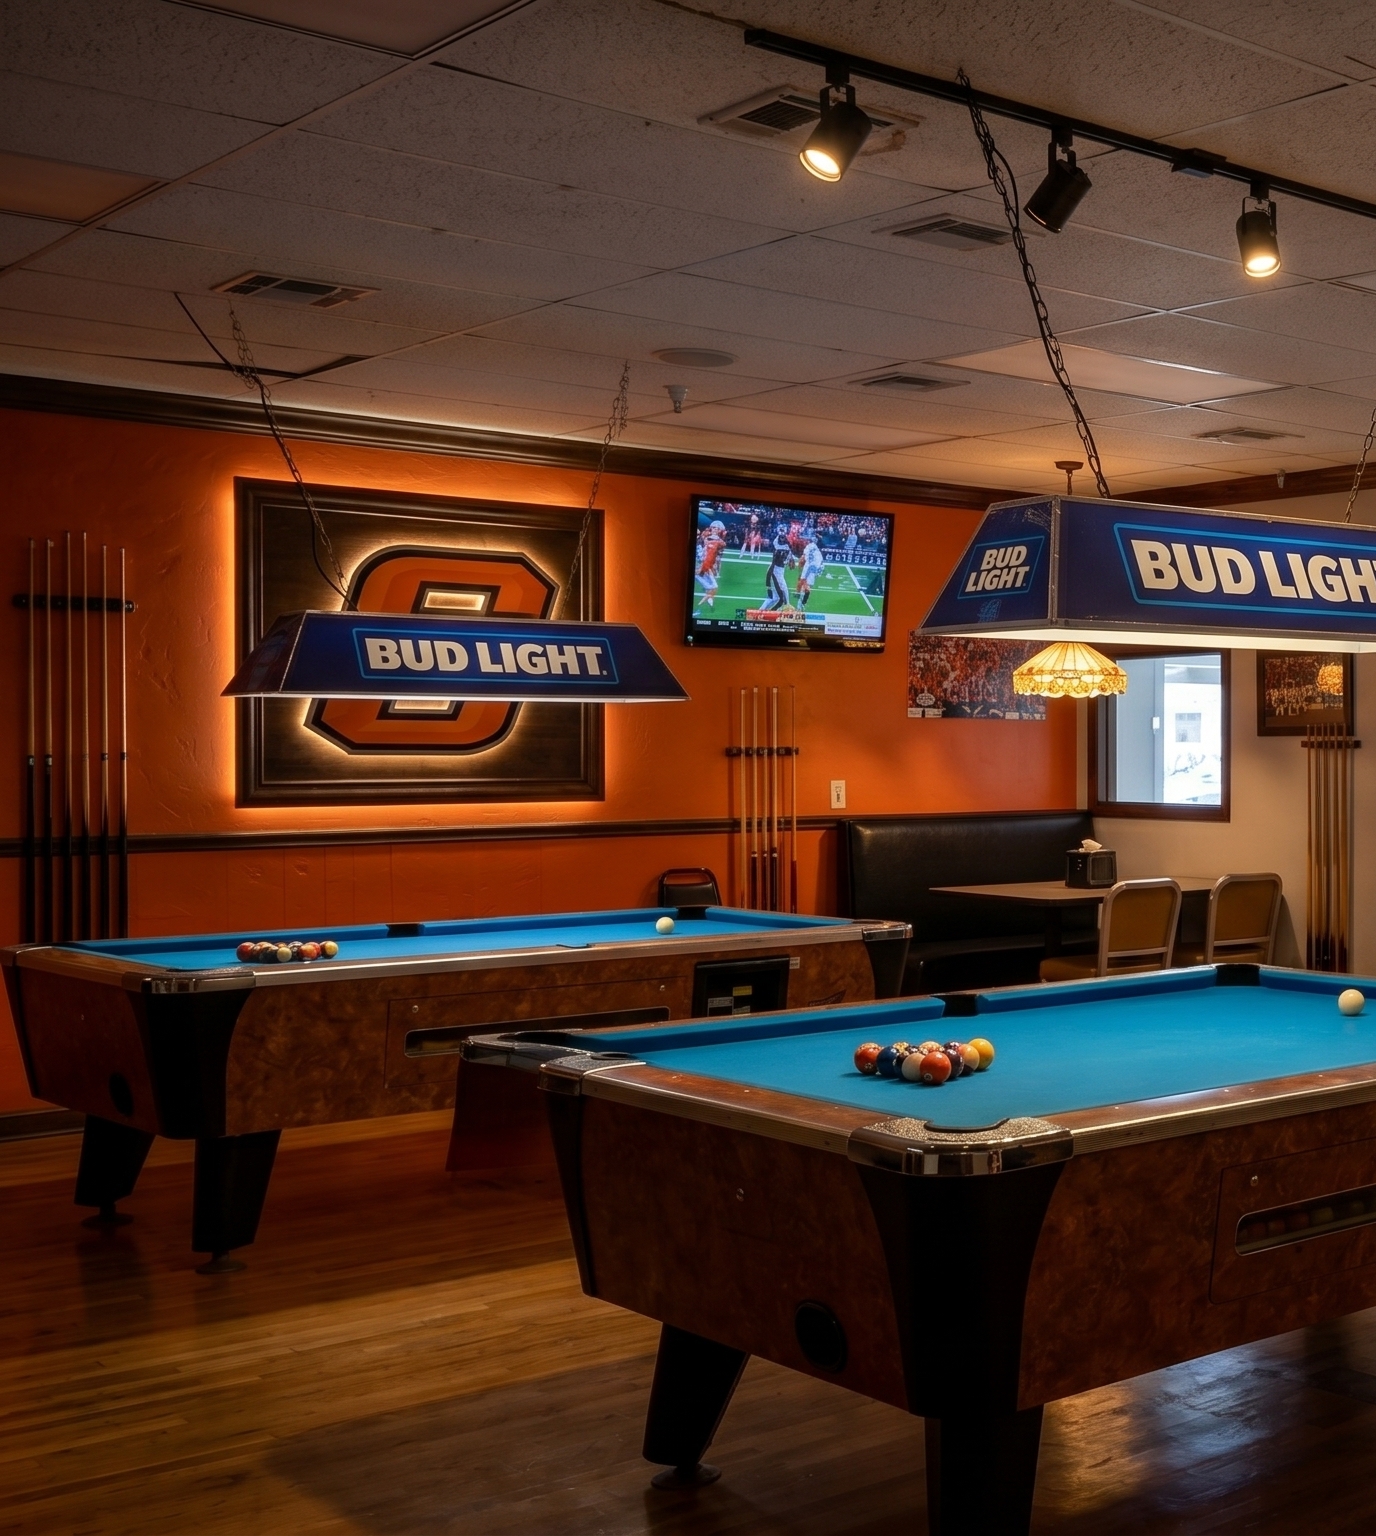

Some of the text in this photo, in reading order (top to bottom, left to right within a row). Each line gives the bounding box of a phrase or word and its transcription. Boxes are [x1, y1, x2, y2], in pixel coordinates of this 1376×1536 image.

[980, 546, 1028, 570] BUD
[1132, 538, 1257, 595] BUD
[965, 567, 1030, 592] LIGHT
[365, 638, 604, 676] BUD LIGHT
